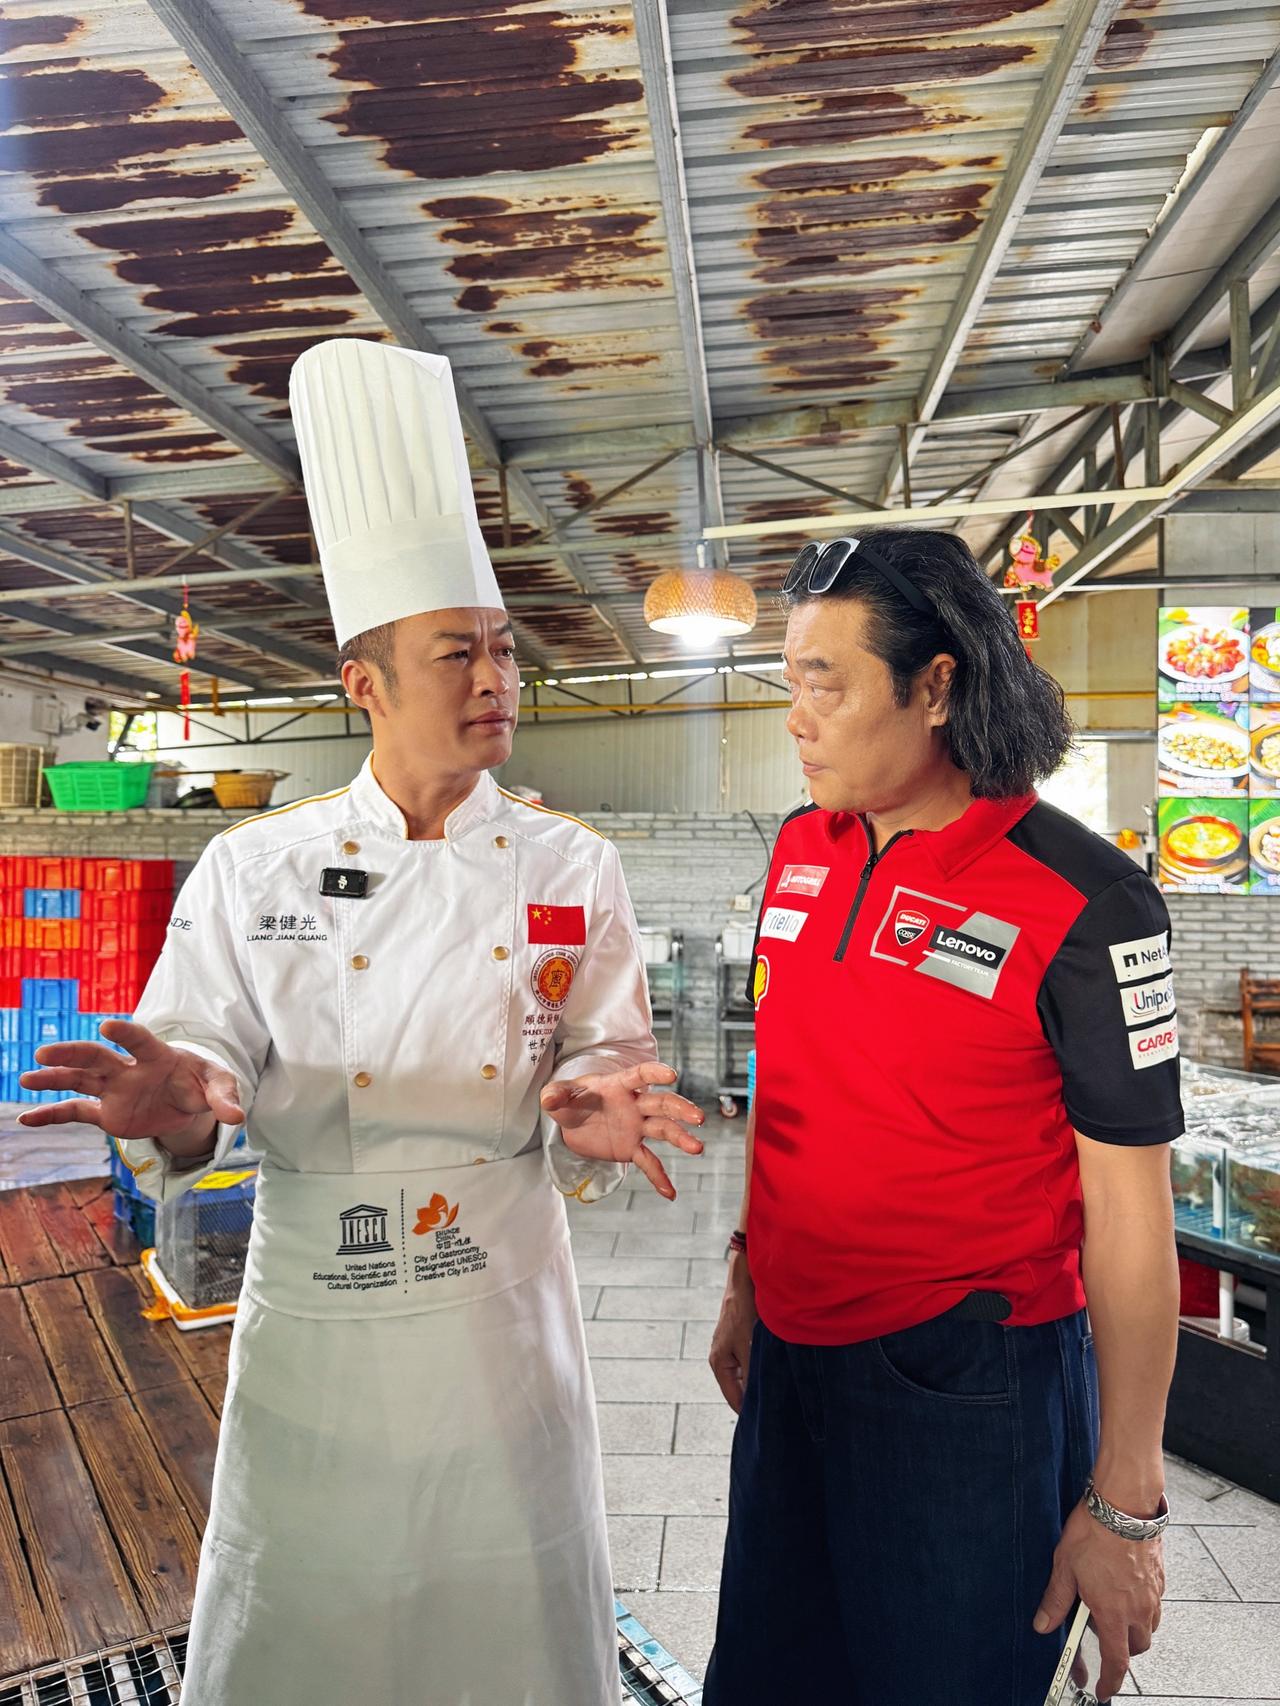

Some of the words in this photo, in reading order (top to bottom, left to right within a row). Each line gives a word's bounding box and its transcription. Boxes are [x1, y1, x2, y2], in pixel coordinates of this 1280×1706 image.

[259, 914, 317, 931] 梁健光
[899, 913, 927, 926] DUCATI
[936, 930, 996, 962] Lenovo
[341, 1216, 387, 1245] UNESCO
[414, 1255, 428, 1264] City
[430, 1252, 437, 1260] of
[439, 1246, 480, 1259] Gastronomy
[415, 1260, 455, 1272] Designated
[456, 1251, 488, 1265] UNESCO
[345, 1263, 367, 1271] United
[368, 1260, 396, 1270] Nations
[415, 1271, 446, 1282] Creative
[447, 1267, 461, 1276] City
[462, 1265, 469, 1273] in
[470, 1261, 486, 1272] 2014
[313, 1272, 349, 1281] Educational,
[350, 1270, 381, 1280] Scientific
[382, 1269, 397, 1277] and
[327, 1281, 352, 1290] Cultural
[353, 1278, 397, 1290] Organization
